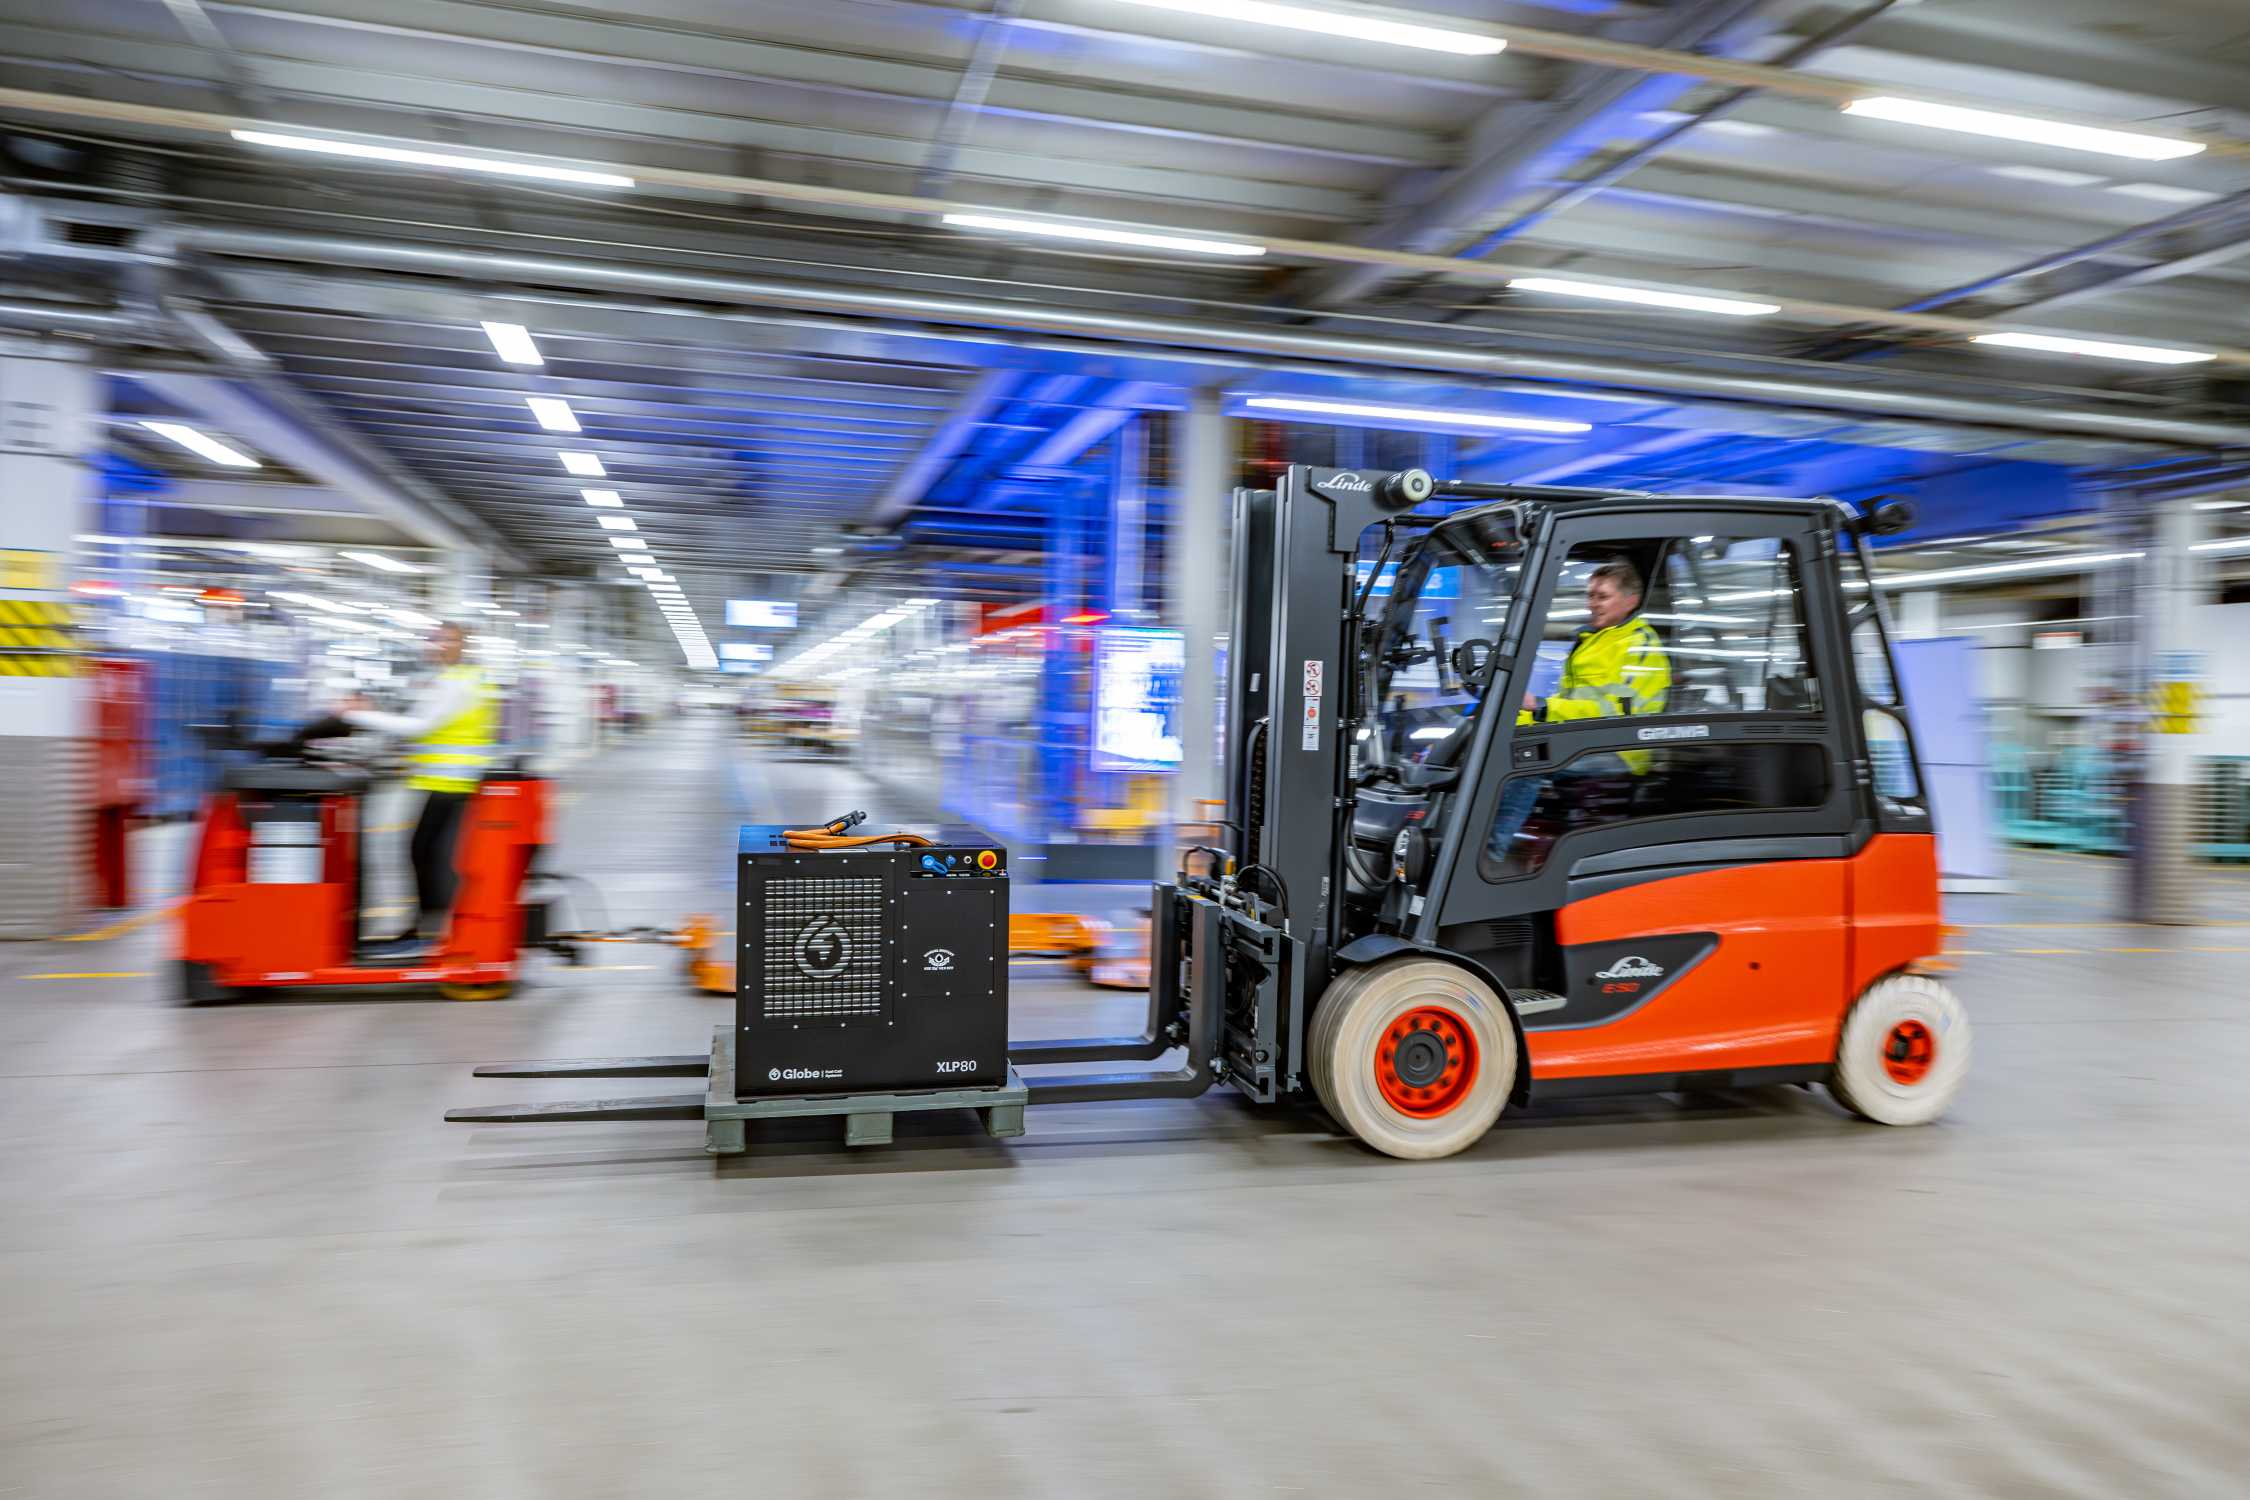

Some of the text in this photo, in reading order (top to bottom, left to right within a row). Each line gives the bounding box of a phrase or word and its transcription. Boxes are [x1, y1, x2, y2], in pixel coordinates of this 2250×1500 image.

[1317, 472, 1372, 492] Linde
[1595, 956, 1664, 978] Linde
[782, 1067, 820, 1080] Globe
[936, 1060, 977, 1073] XLP80
